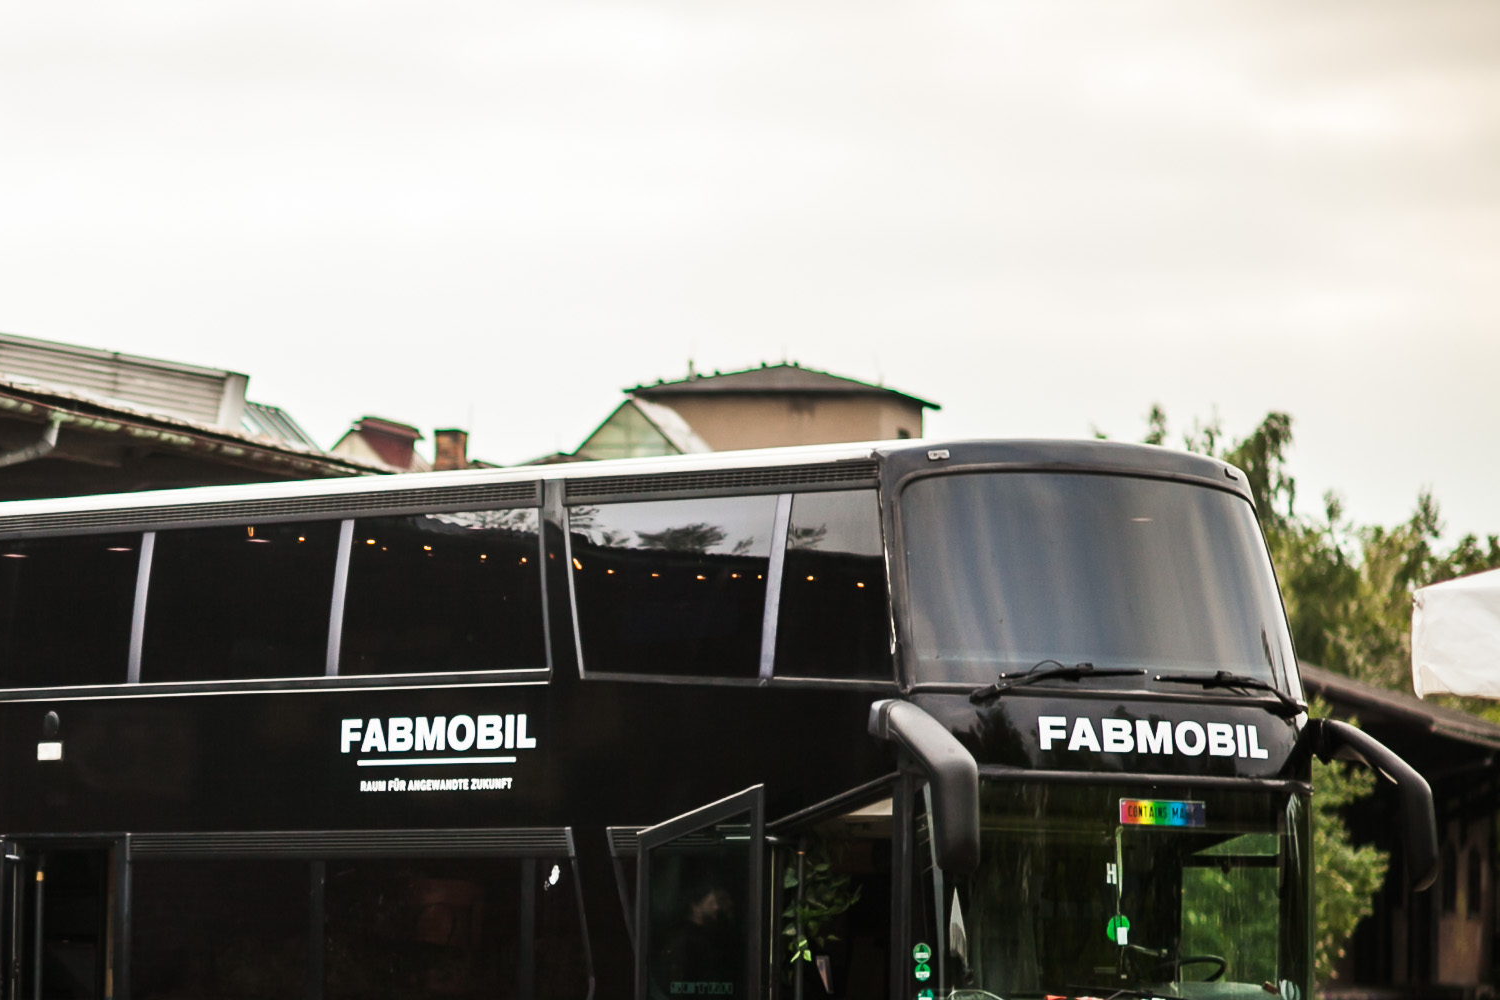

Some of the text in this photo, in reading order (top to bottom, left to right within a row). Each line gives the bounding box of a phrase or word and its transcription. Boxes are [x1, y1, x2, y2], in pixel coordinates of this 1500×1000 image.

[340, 713, 537, 754] FABMOBIL
[1038, 715, 1269, 760] FABMOBIL
[360, 777, 513, 792] RAUM FÜR ANGEWANDTE ZUKUNFT
[1127, 805, 1168, 819] CONTAINS
